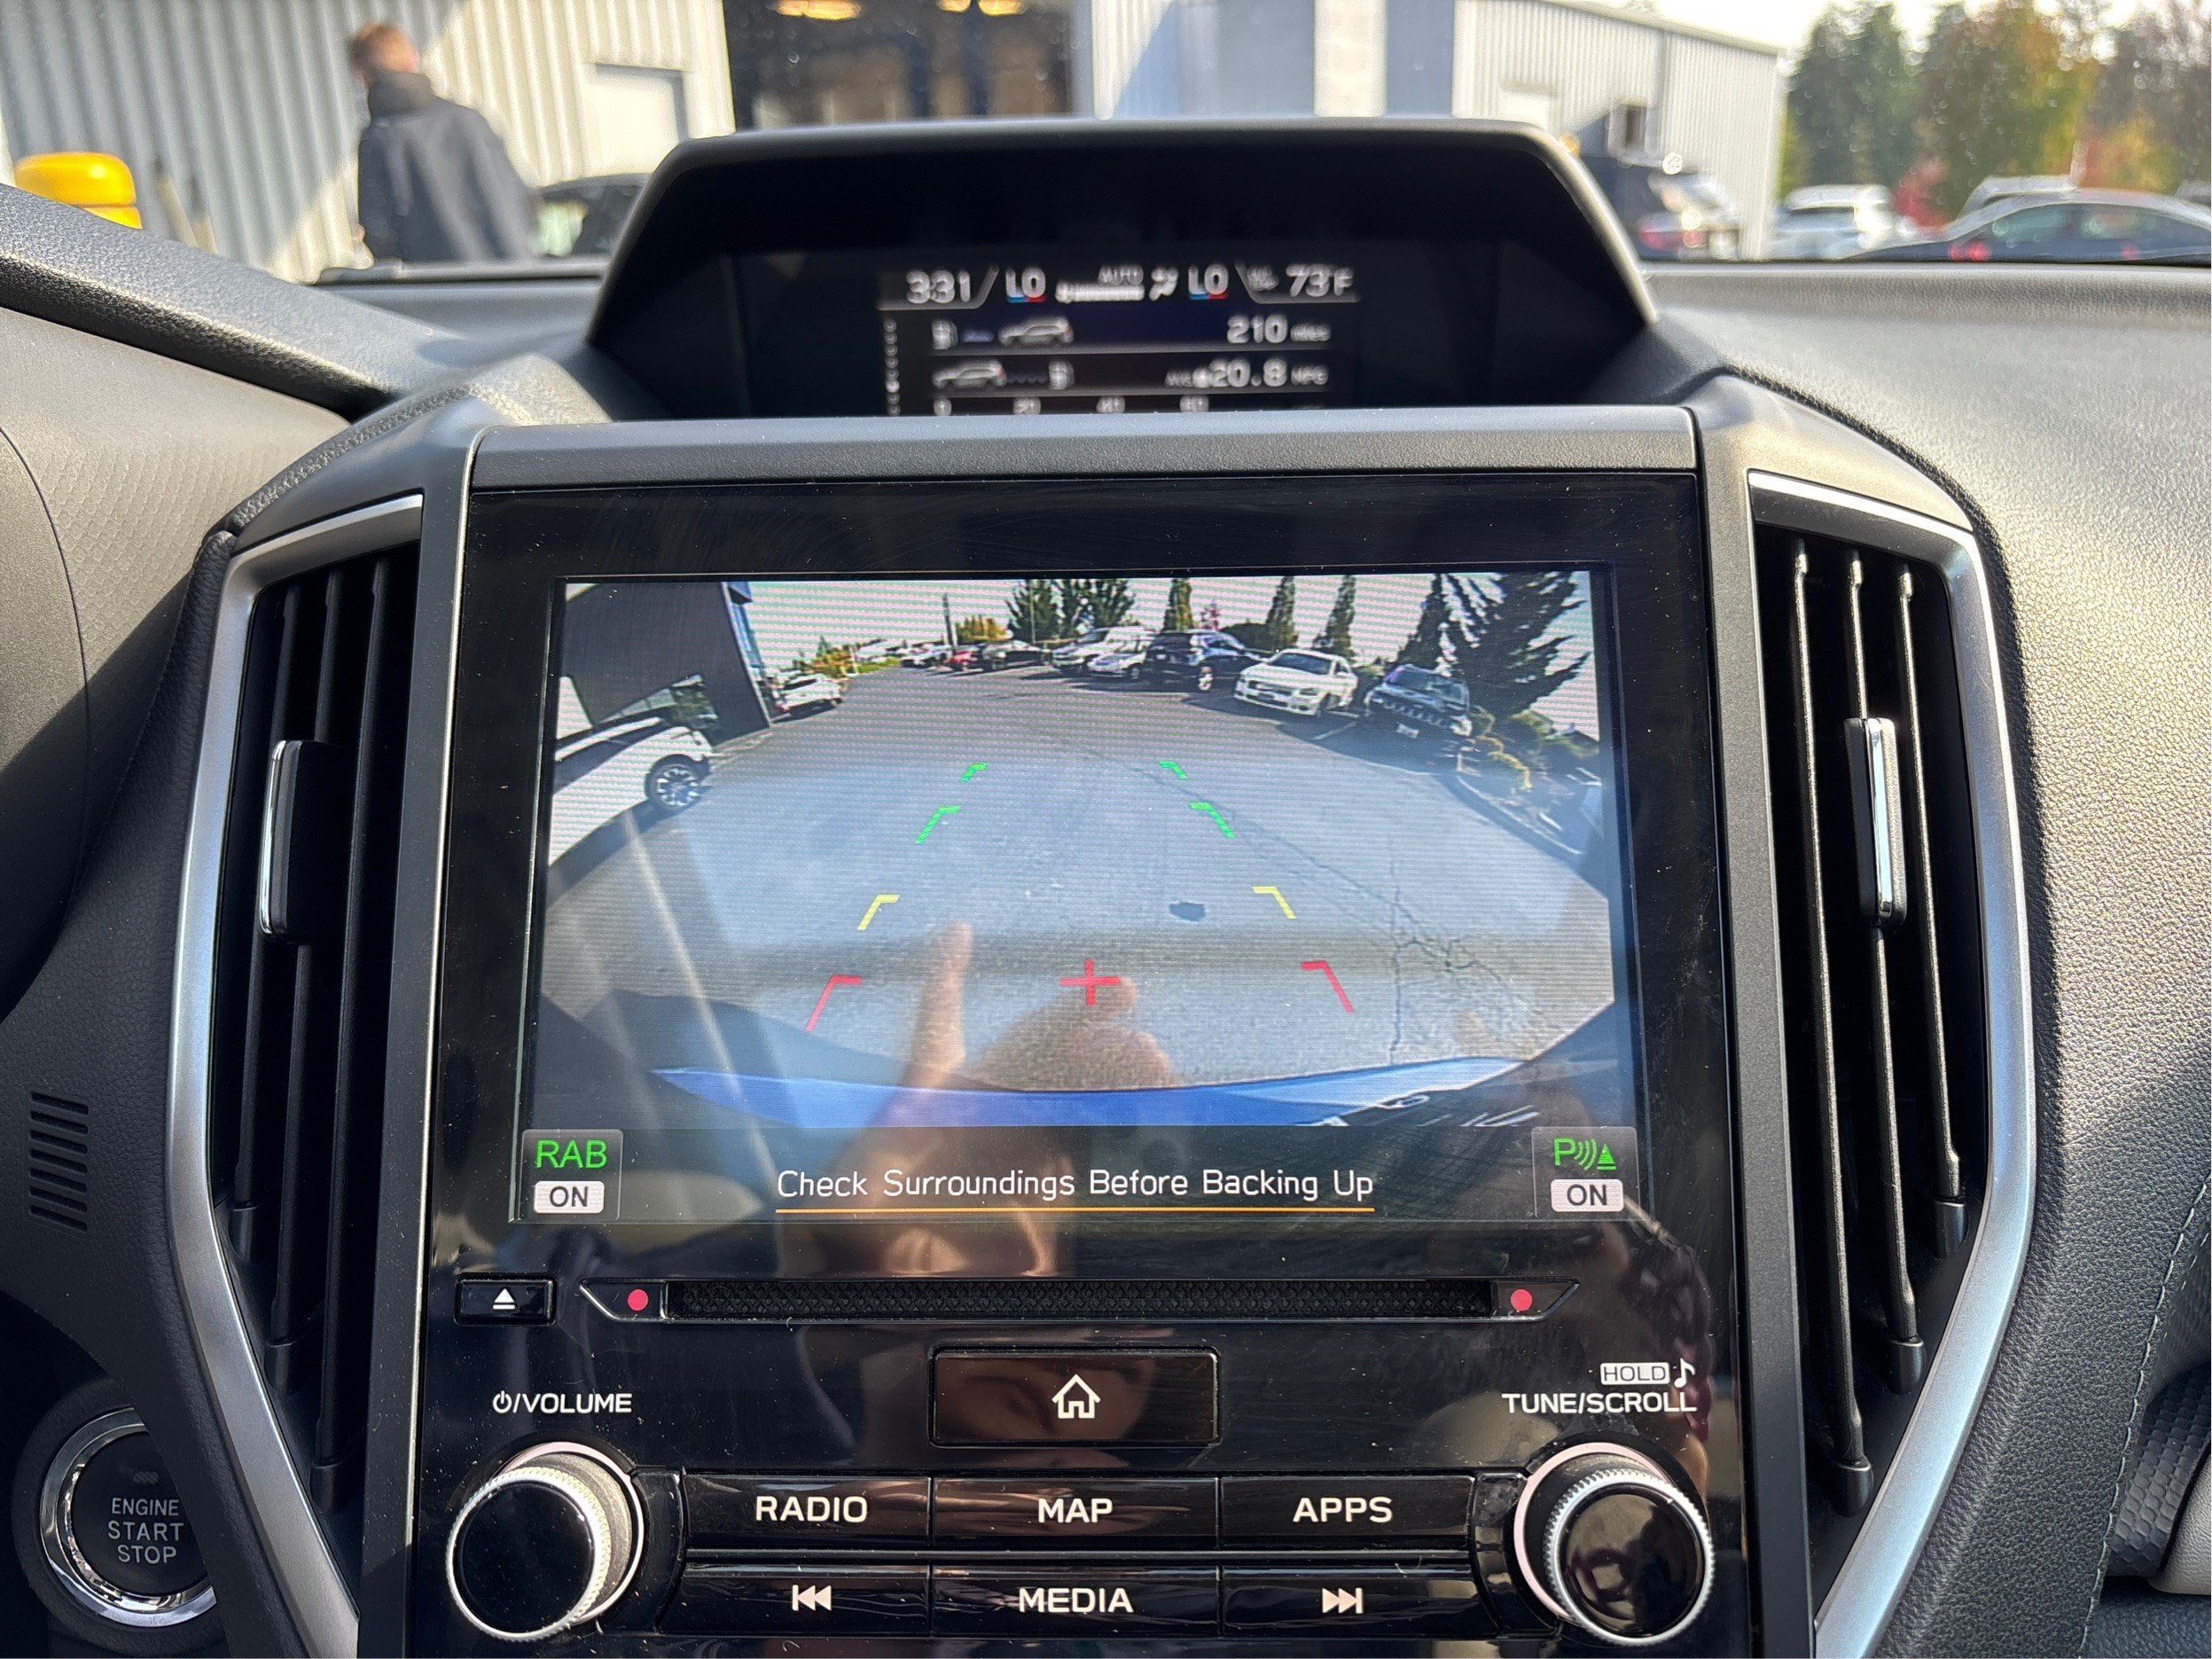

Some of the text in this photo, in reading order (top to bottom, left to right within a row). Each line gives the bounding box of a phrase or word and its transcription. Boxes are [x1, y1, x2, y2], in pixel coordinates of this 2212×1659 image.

[1005, 268, 1047, 299] LO
[1188, 267, 1229, 296] LO
[1227, 315, 1287, 343] 210
[535, 1139, 607, 1169] RAB
[550, 1186, 589, 1208] ON
[777, 1169, 1374, 1201] Check Surroundings Before Backing Up
[1567, 1184, 1607, 1206] ON
[1604, 1366, 1666, 1381] HOLD
[1501, 1391, 1697, 1413] TUNE/SCROLL
[111, 1498, 180, 1517] ENGINE
[755, 1495, 868, 1524] RADIO
[1038, 1497, 1113, 1524] MAP
[1294, 1496, 1393, 1524] APPS
[107, 1520, 184, 1543] START
[117, 1545, 177, 1565] STOP
[1019, 1586, 1133, 1614] MEDIA
